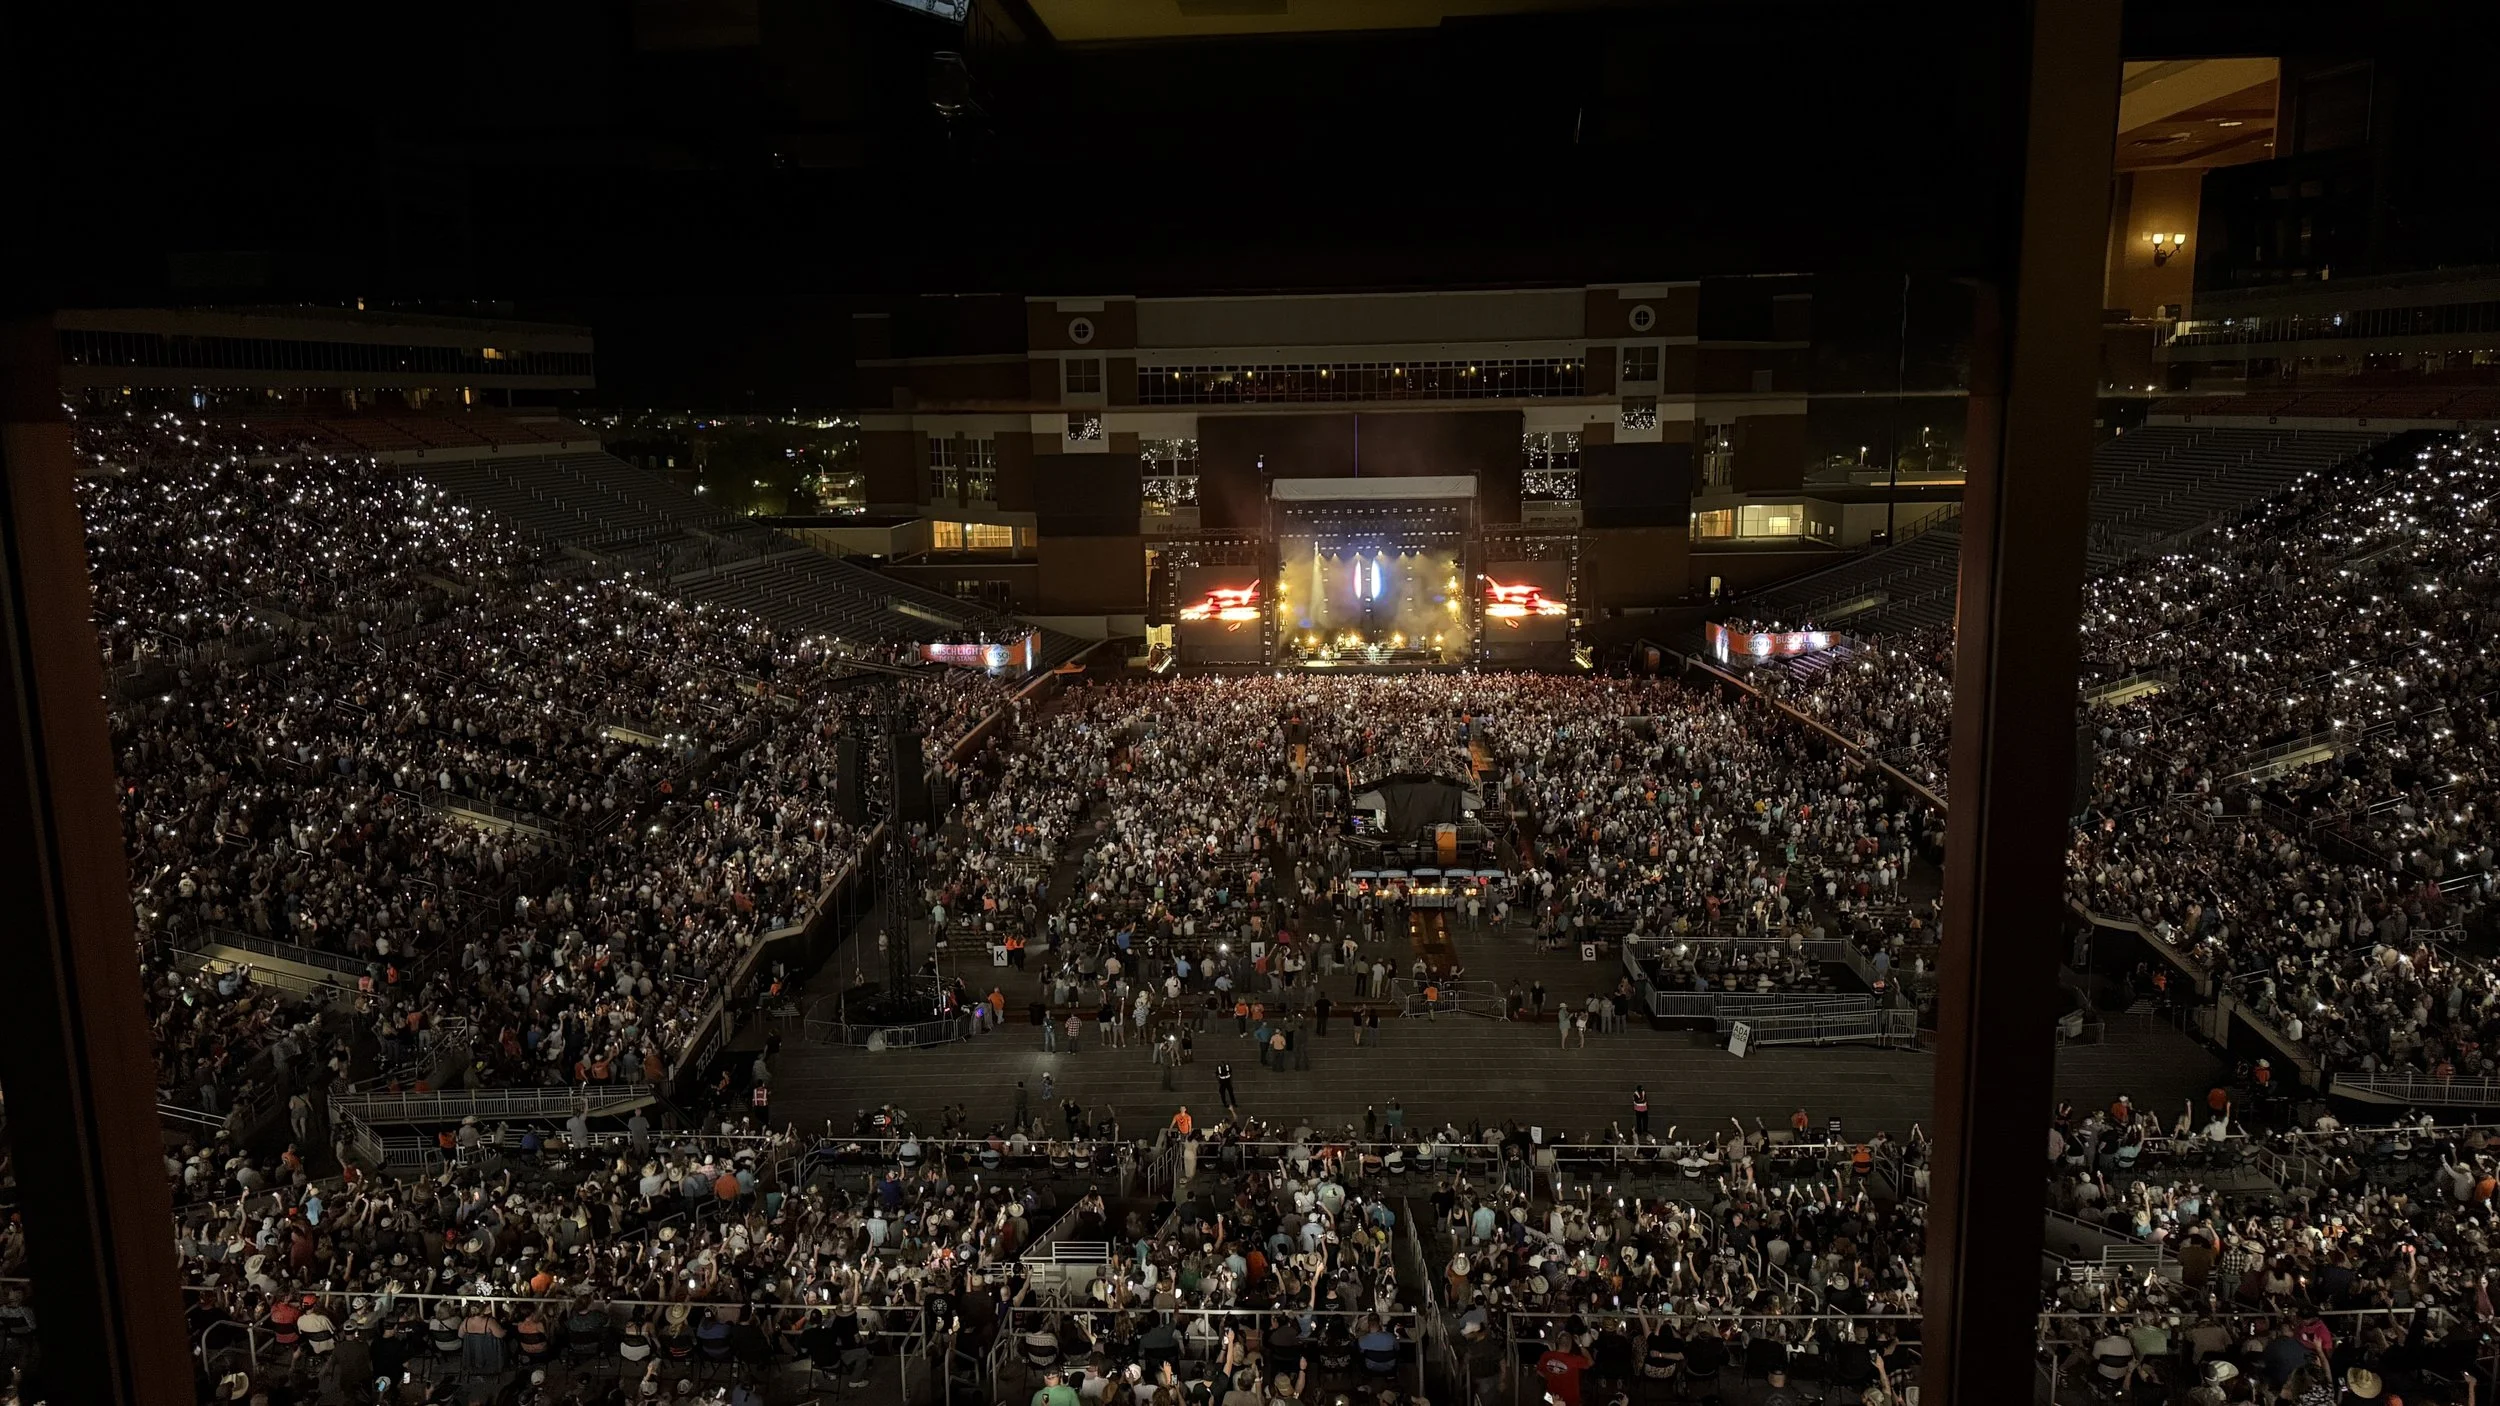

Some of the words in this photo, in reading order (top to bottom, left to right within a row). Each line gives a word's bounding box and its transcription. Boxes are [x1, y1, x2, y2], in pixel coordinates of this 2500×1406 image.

[1747, 640, 1771, 649] BUSH
[1776, 634, 1831, 644] BUSCHLT
[996, 950, 1004, 961] K
[1584, 947, 1594, 958] G
[1734, 1025, 1748, 1036] ADA
